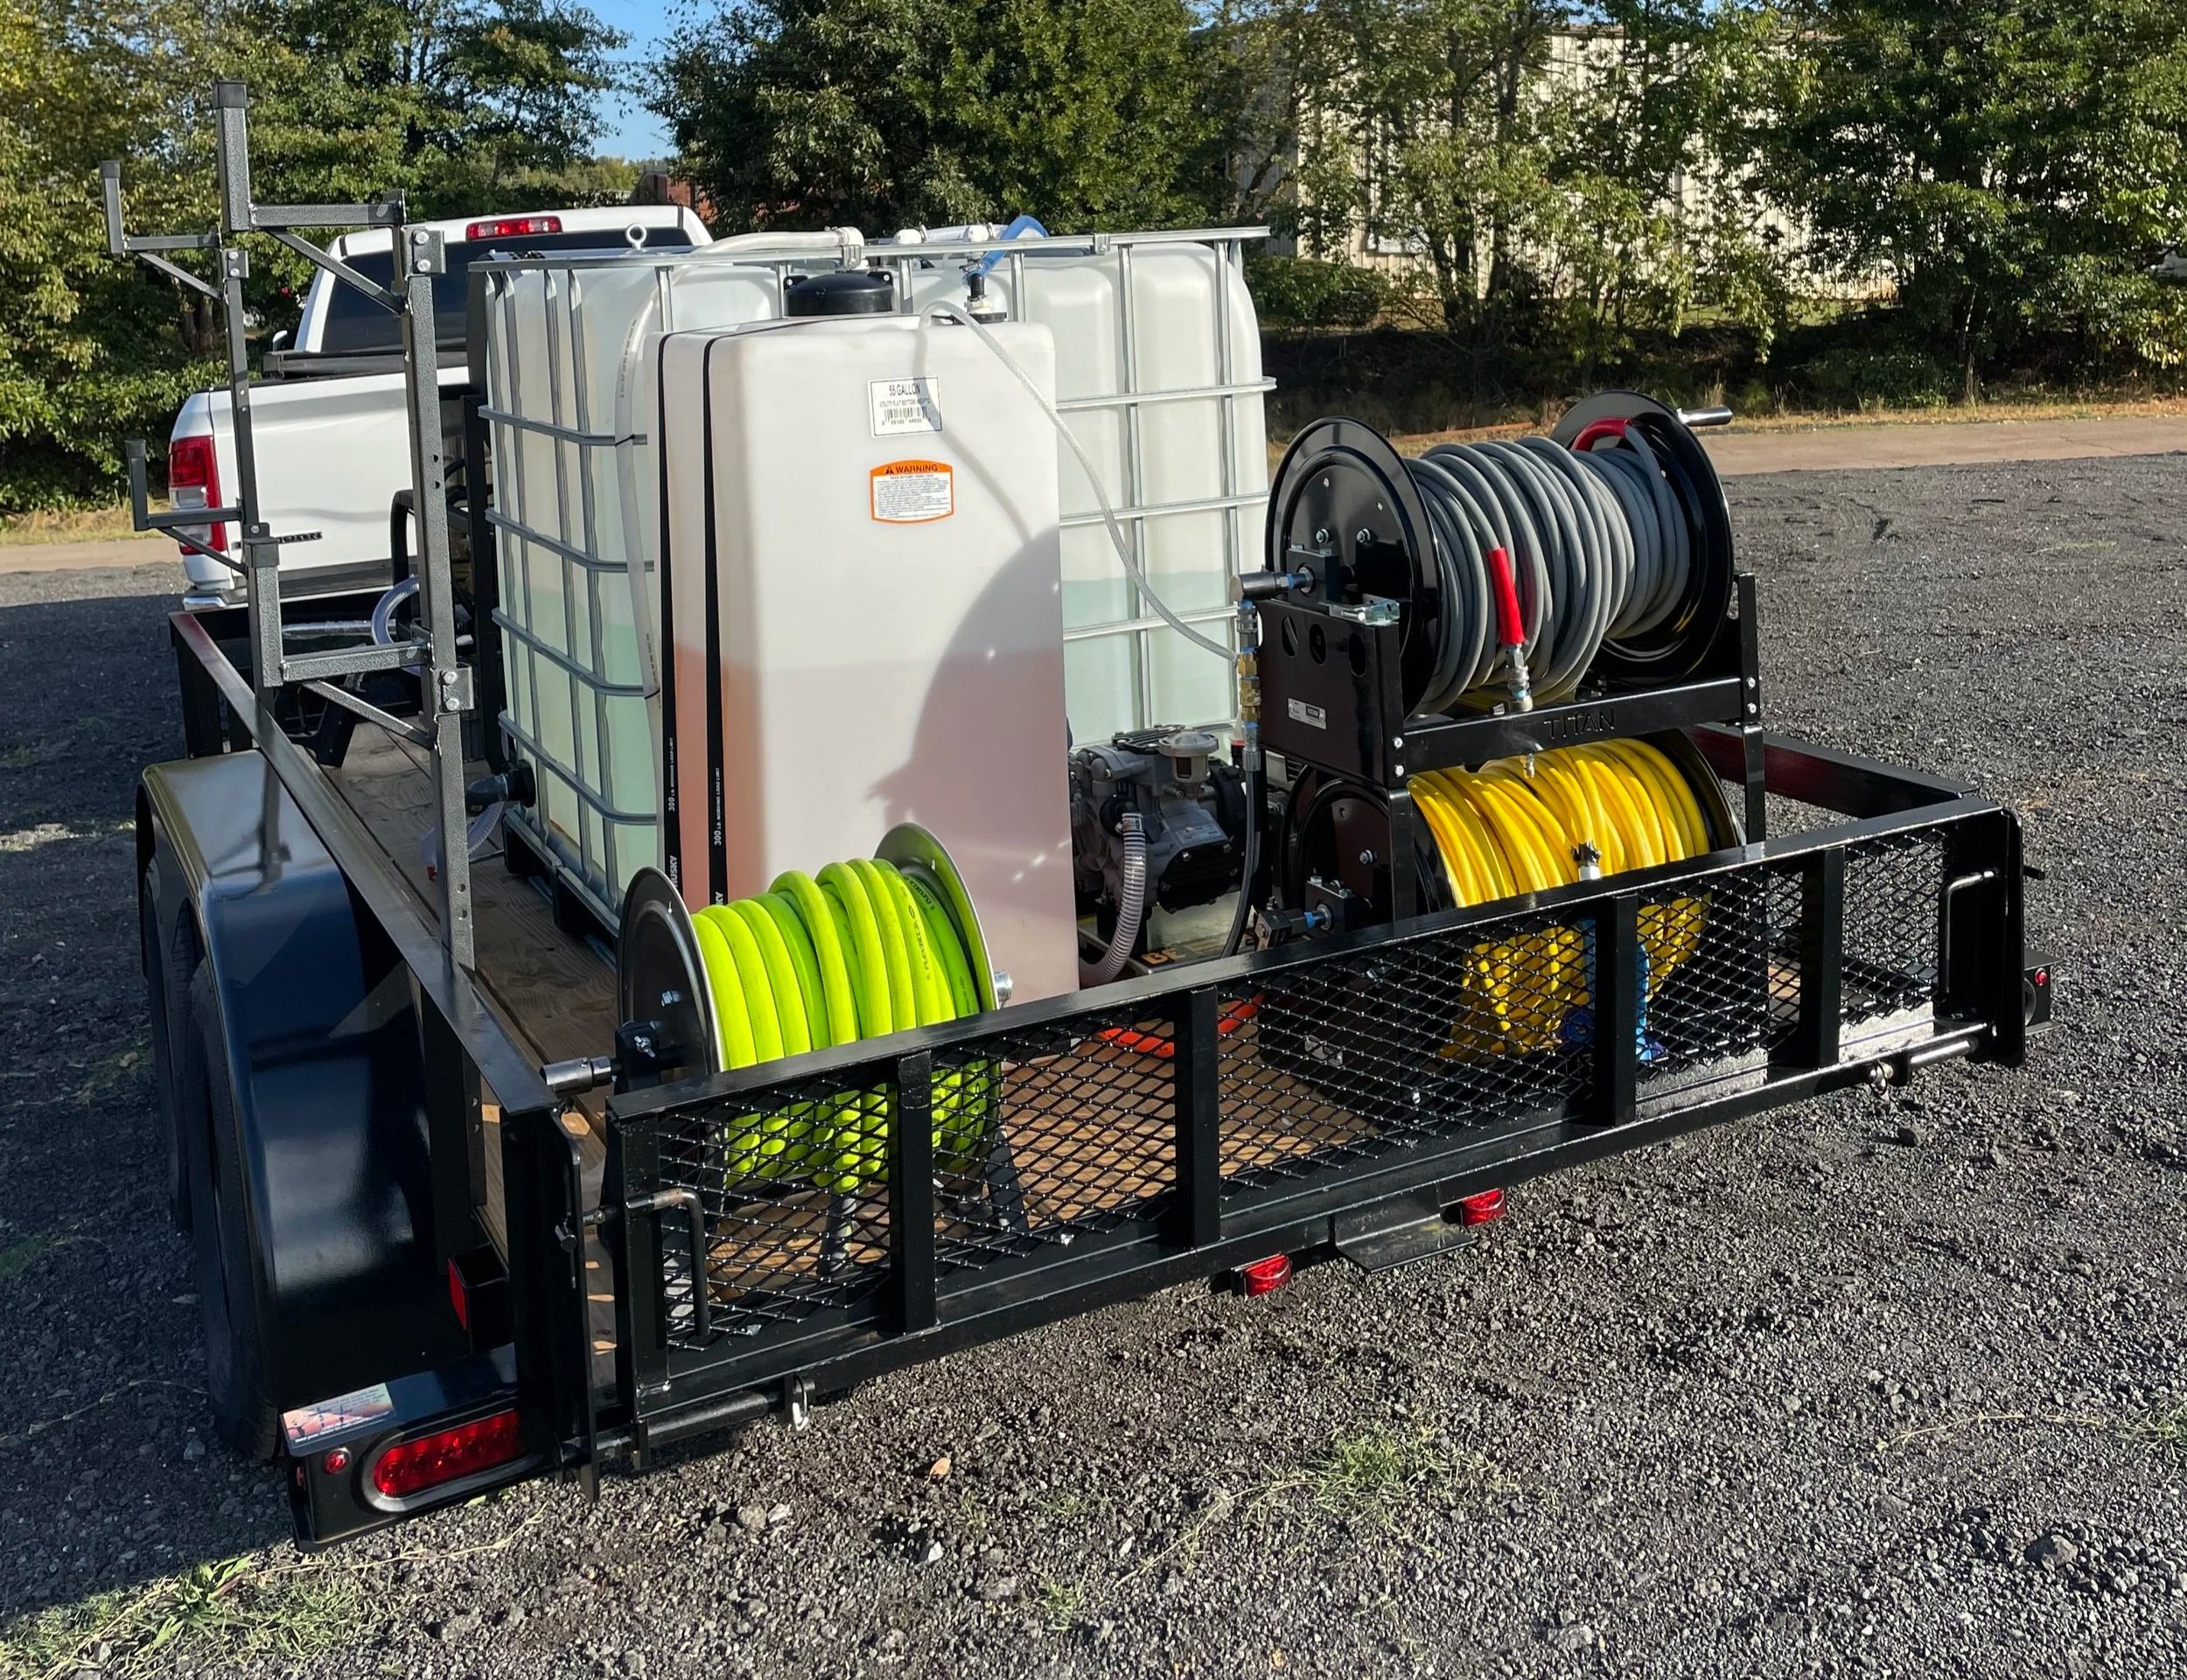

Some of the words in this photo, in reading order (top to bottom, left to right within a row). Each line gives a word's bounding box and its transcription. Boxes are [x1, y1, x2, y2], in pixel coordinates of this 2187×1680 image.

[889, 384, 896, 396] 55
[897, 382, 920, 396] GALLON
[895, 464, 938, 474] WARNING
[1542, 708, 1616, 741] TITAN
